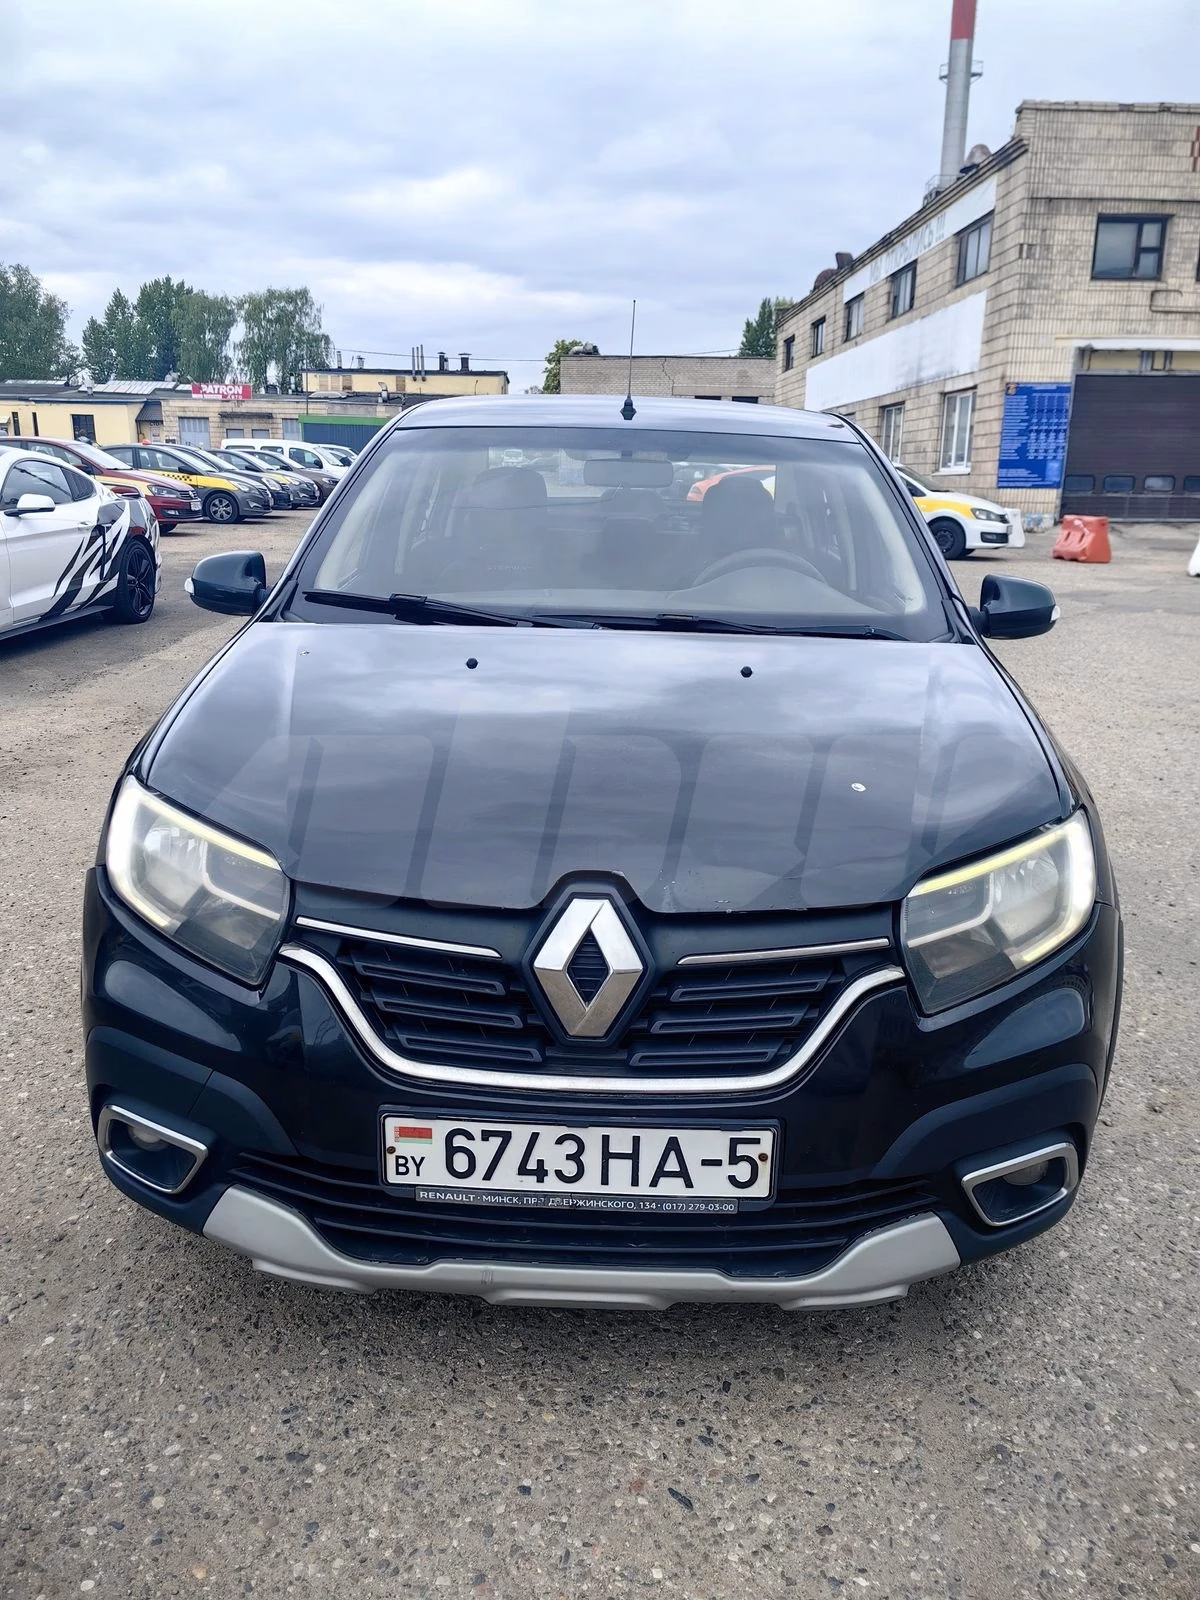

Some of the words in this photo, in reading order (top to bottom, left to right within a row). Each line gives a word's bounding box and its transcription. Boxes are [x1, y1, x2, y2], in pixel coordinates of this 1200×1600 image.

[200, 385, 242, 394] PATRON
[395, 1155, 425, 1176] BY
[420, 1191, 475, 1201] RENAULT
[482, 1195, 521, 1205] МИНСК,
[662, 1202, 686, 1211] (017)
[688, 1203, 735, 1212] 279-03-00
